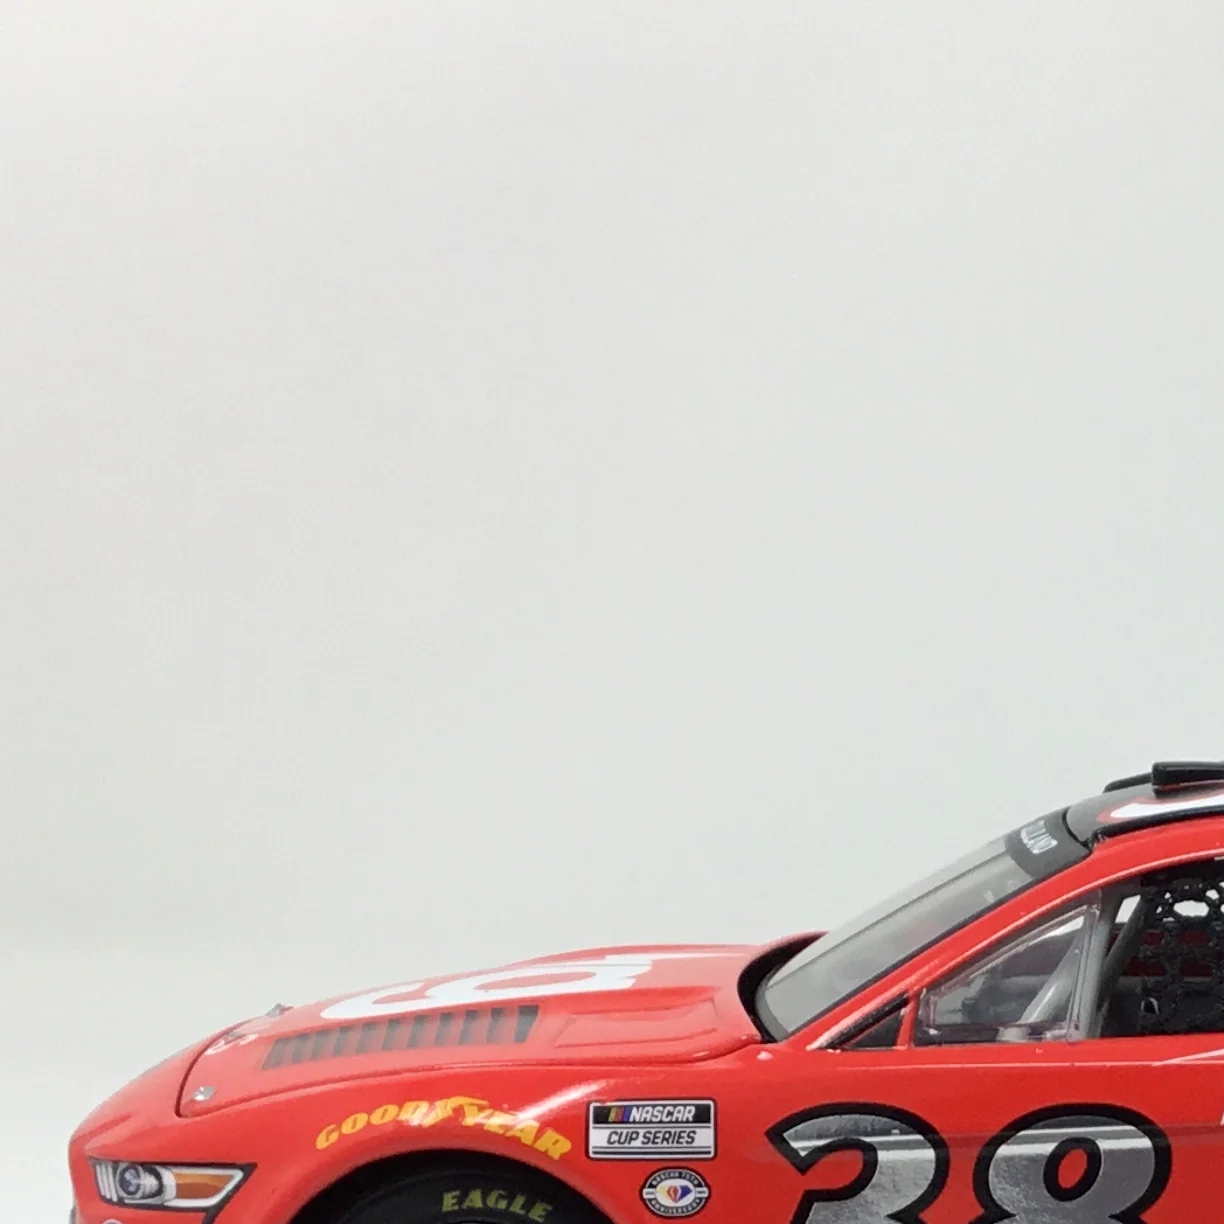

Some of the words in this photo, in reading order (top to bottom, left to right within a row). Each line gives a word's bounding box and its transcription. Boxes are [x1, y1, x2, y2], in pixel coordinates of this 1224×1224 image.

[628, 1105, 696, 1122] NASCAR
[315, 1095, 572, 1161] GOODYEAR
[606, 1130, 640, 1146] CUP
[640, 1130, 697, 1146] SERIES
[441, 1189, 553, 1223] EAGLE
